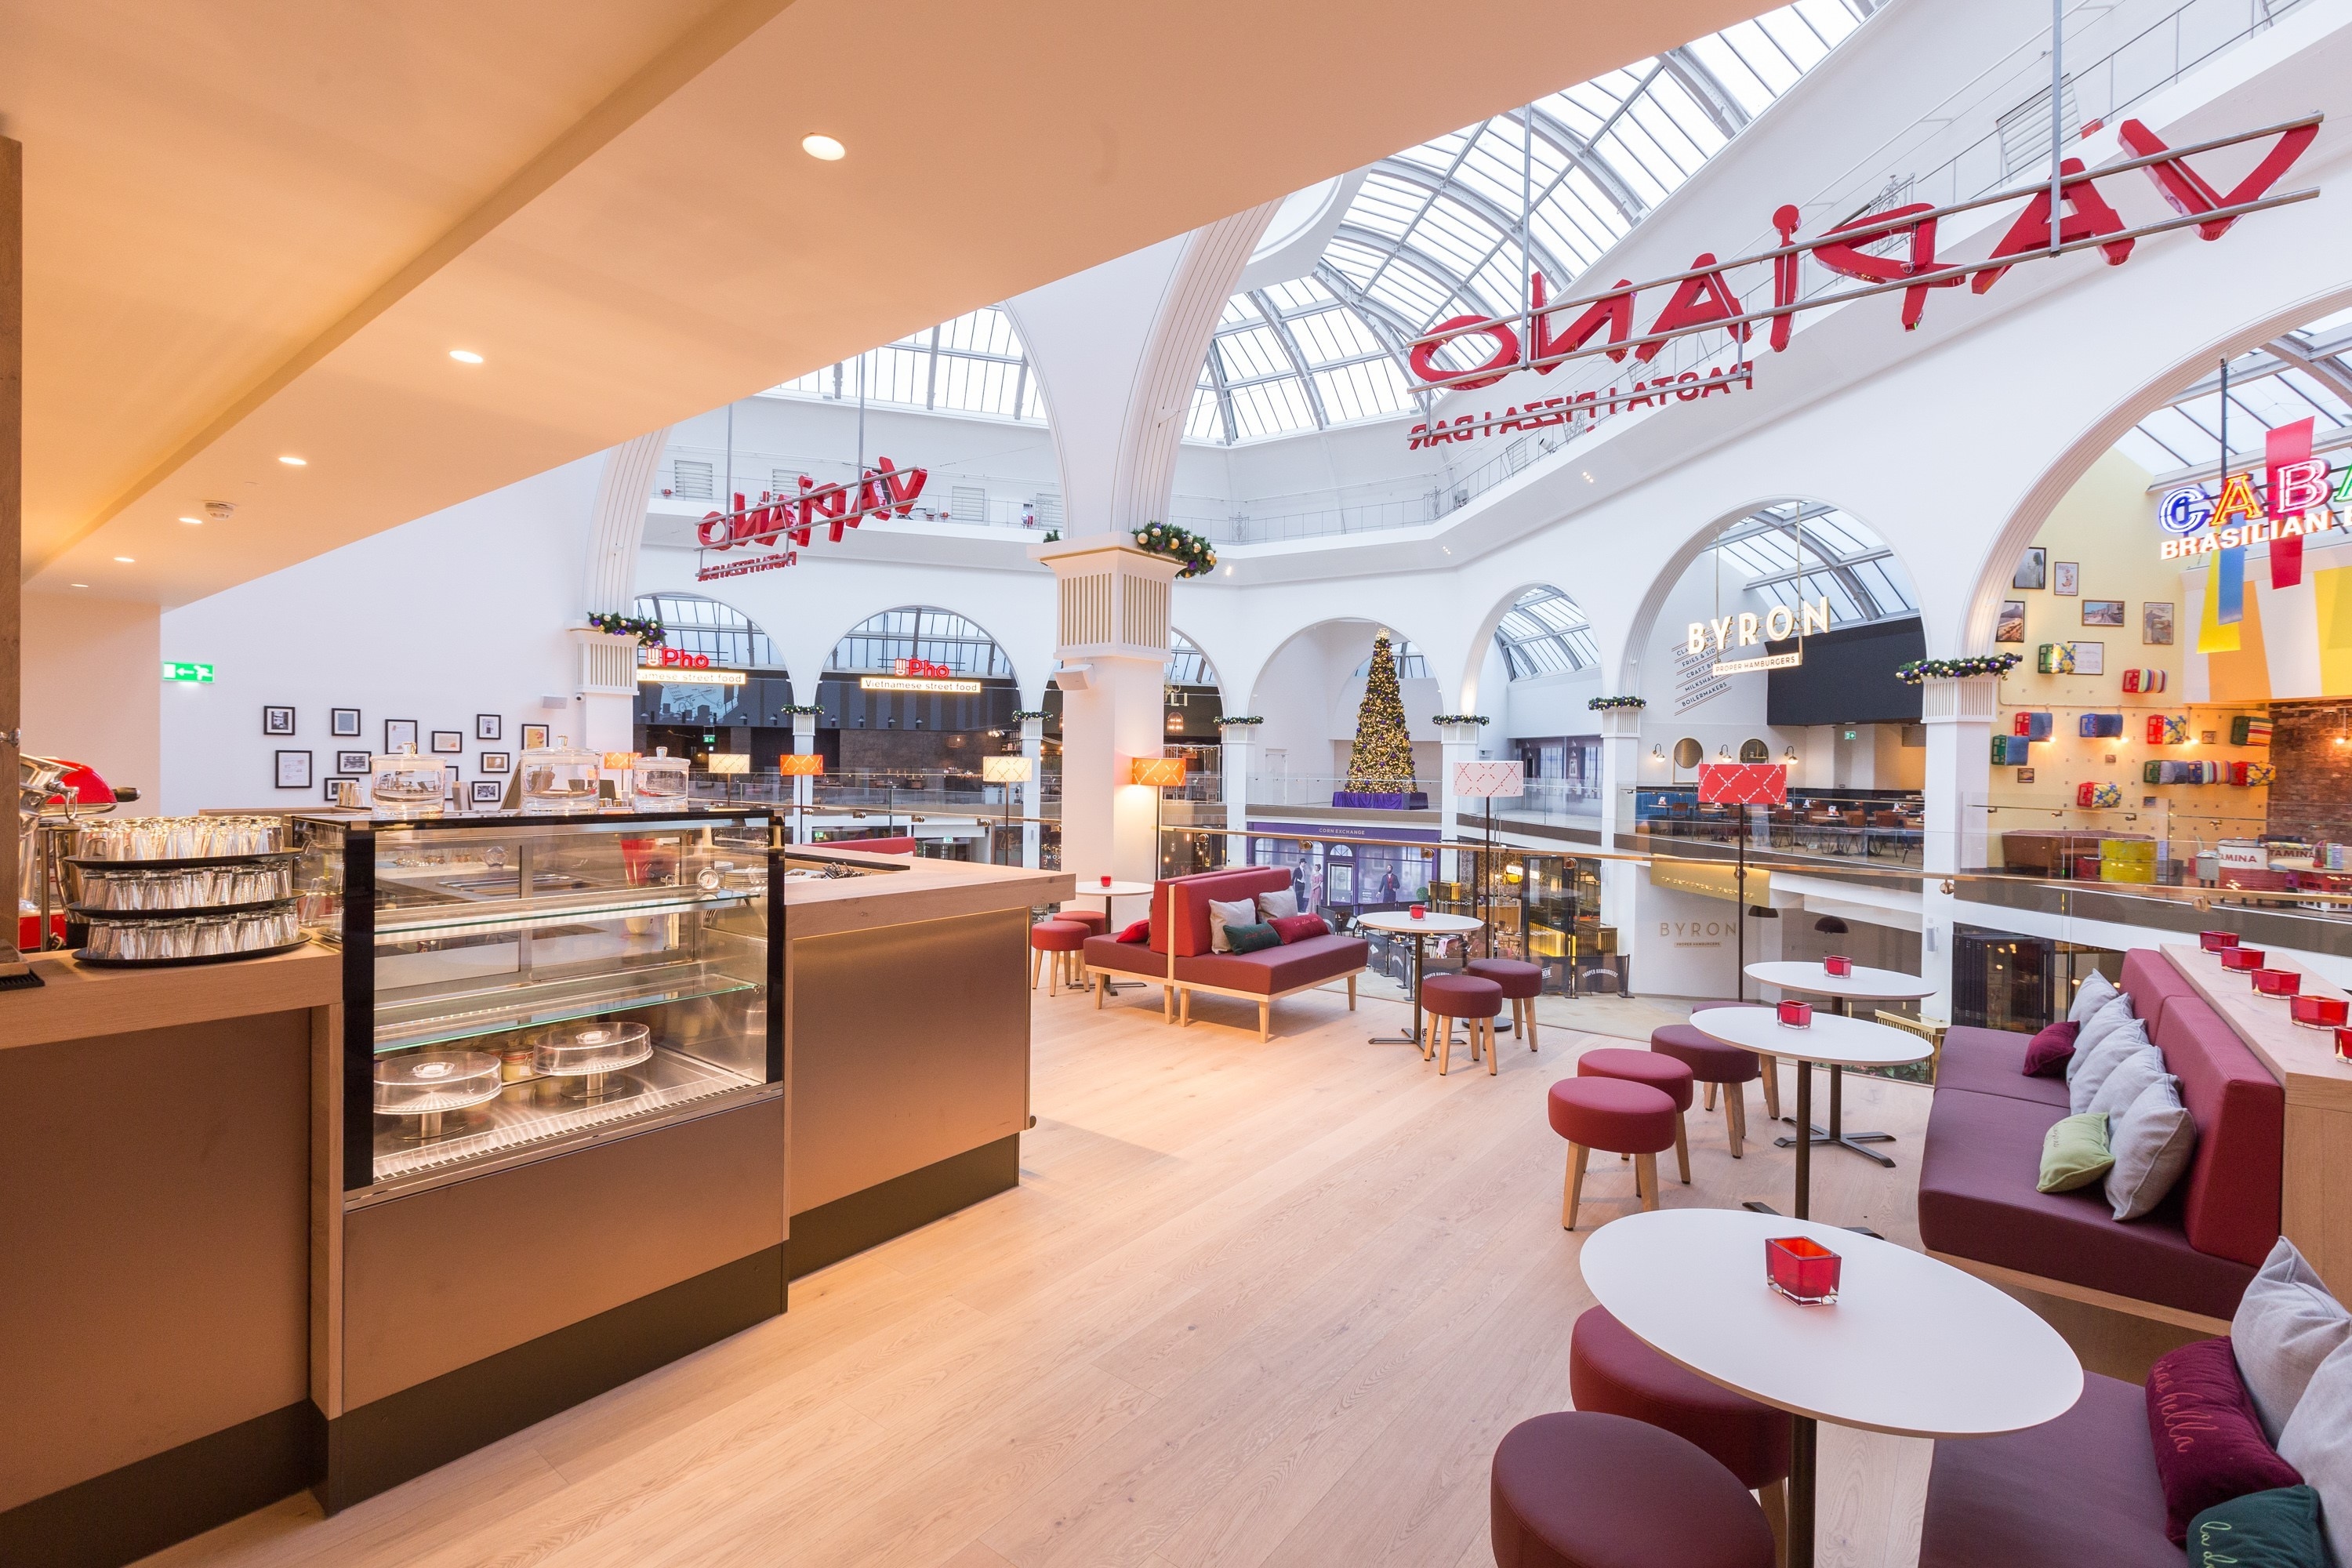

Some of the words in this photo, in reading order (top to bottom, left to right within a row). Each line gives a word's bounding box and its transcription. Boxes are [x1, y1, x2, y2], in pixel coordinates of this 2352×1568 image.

[2160, 510, 2334, 560] BRASILIAN
[1688, 596, 1831, 654] BYRON
[662, 648, 710, 669] Pho
[1682, 655, 1699, 666] FRIES
[1716, 663, 1742, 672] PROPER
[1744, 656, 1795, 668] HAMBURGERS
[908, 658, 950, 679] Pho
[1686, 666, 1705, 678] CRAFT
[683, 673, 713, 682] street
[718, 673, 742, 683] food
[866, 680, 922, 689] Vietnamese
[1682, 682, 1727, 706] BOILERMAKERS
[1660, 922, 1737, 936] BYRON
